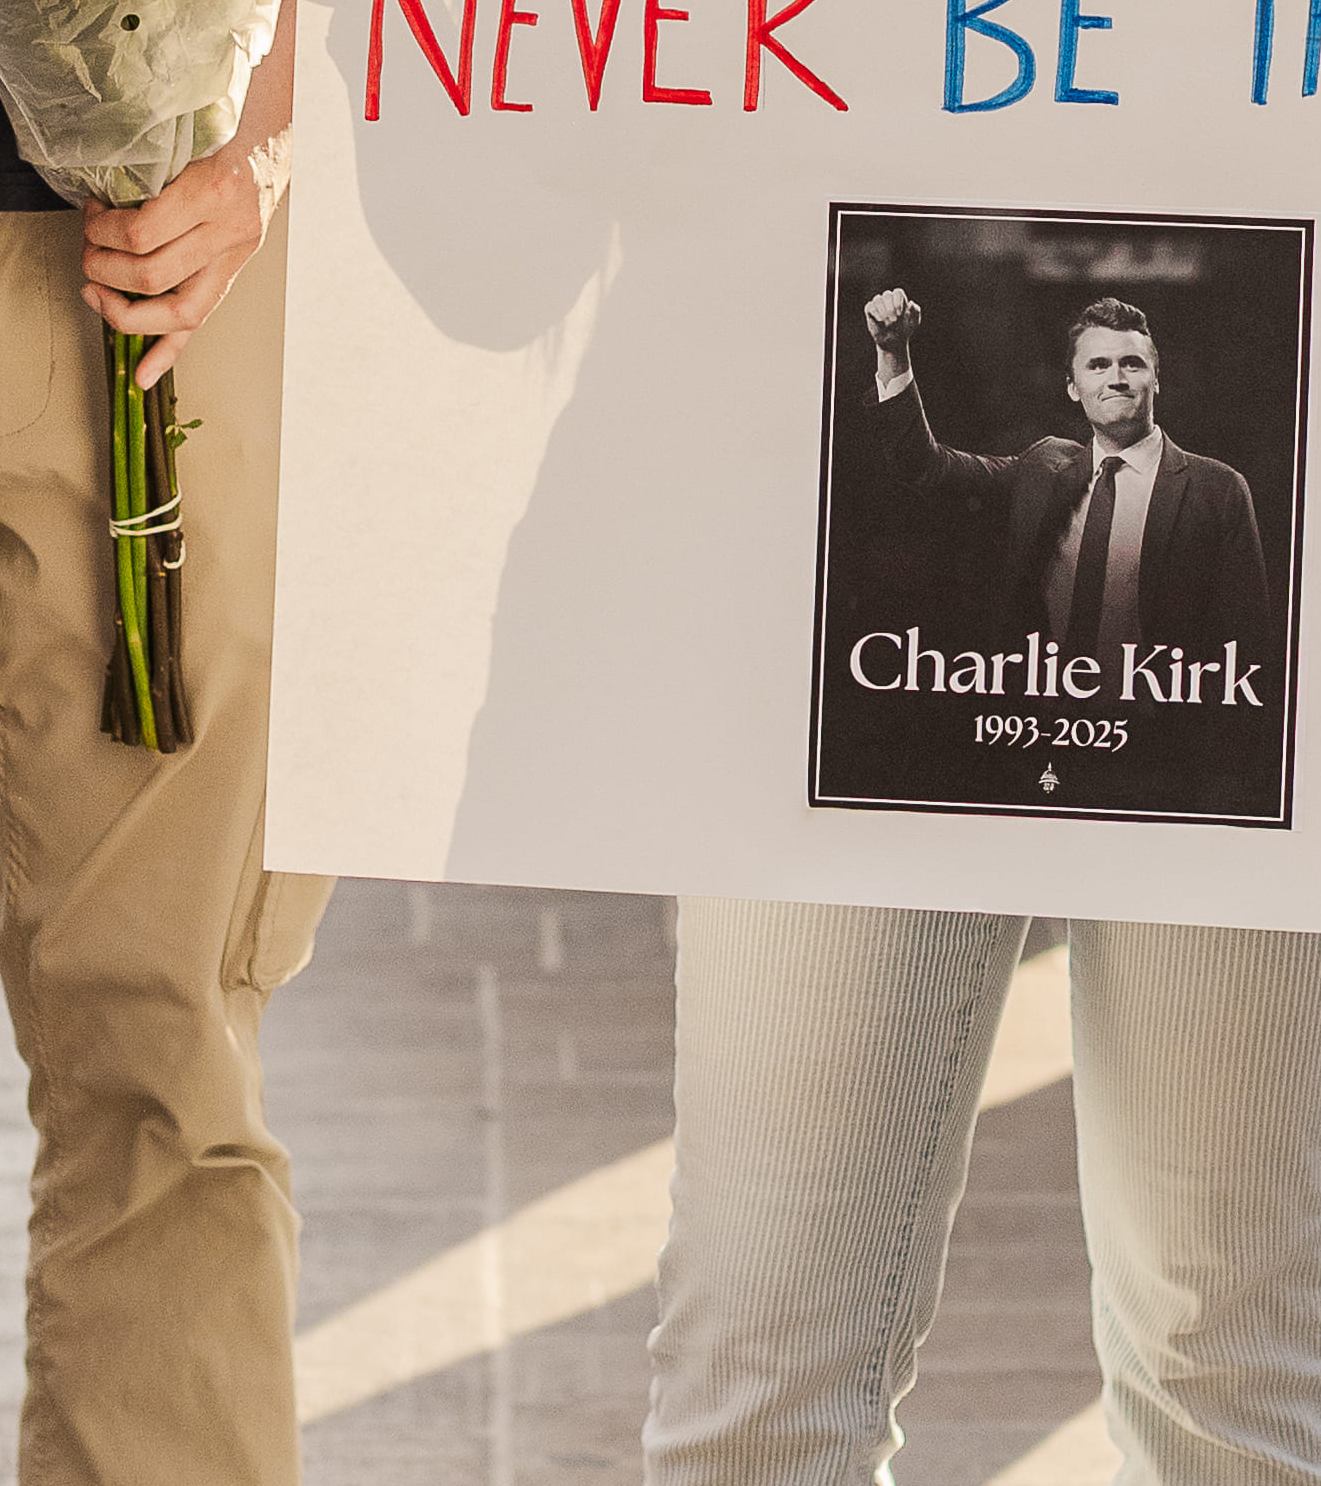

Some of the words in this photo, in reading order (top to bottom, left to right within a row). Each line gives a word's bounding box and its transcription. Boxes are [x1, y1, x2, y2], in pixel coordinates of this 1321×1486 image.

[849, 626, 1102, 699] Charlie
[1119, 640, 1264, 707] Kirk
[973, 713, 1129, 753] 1993-2025
